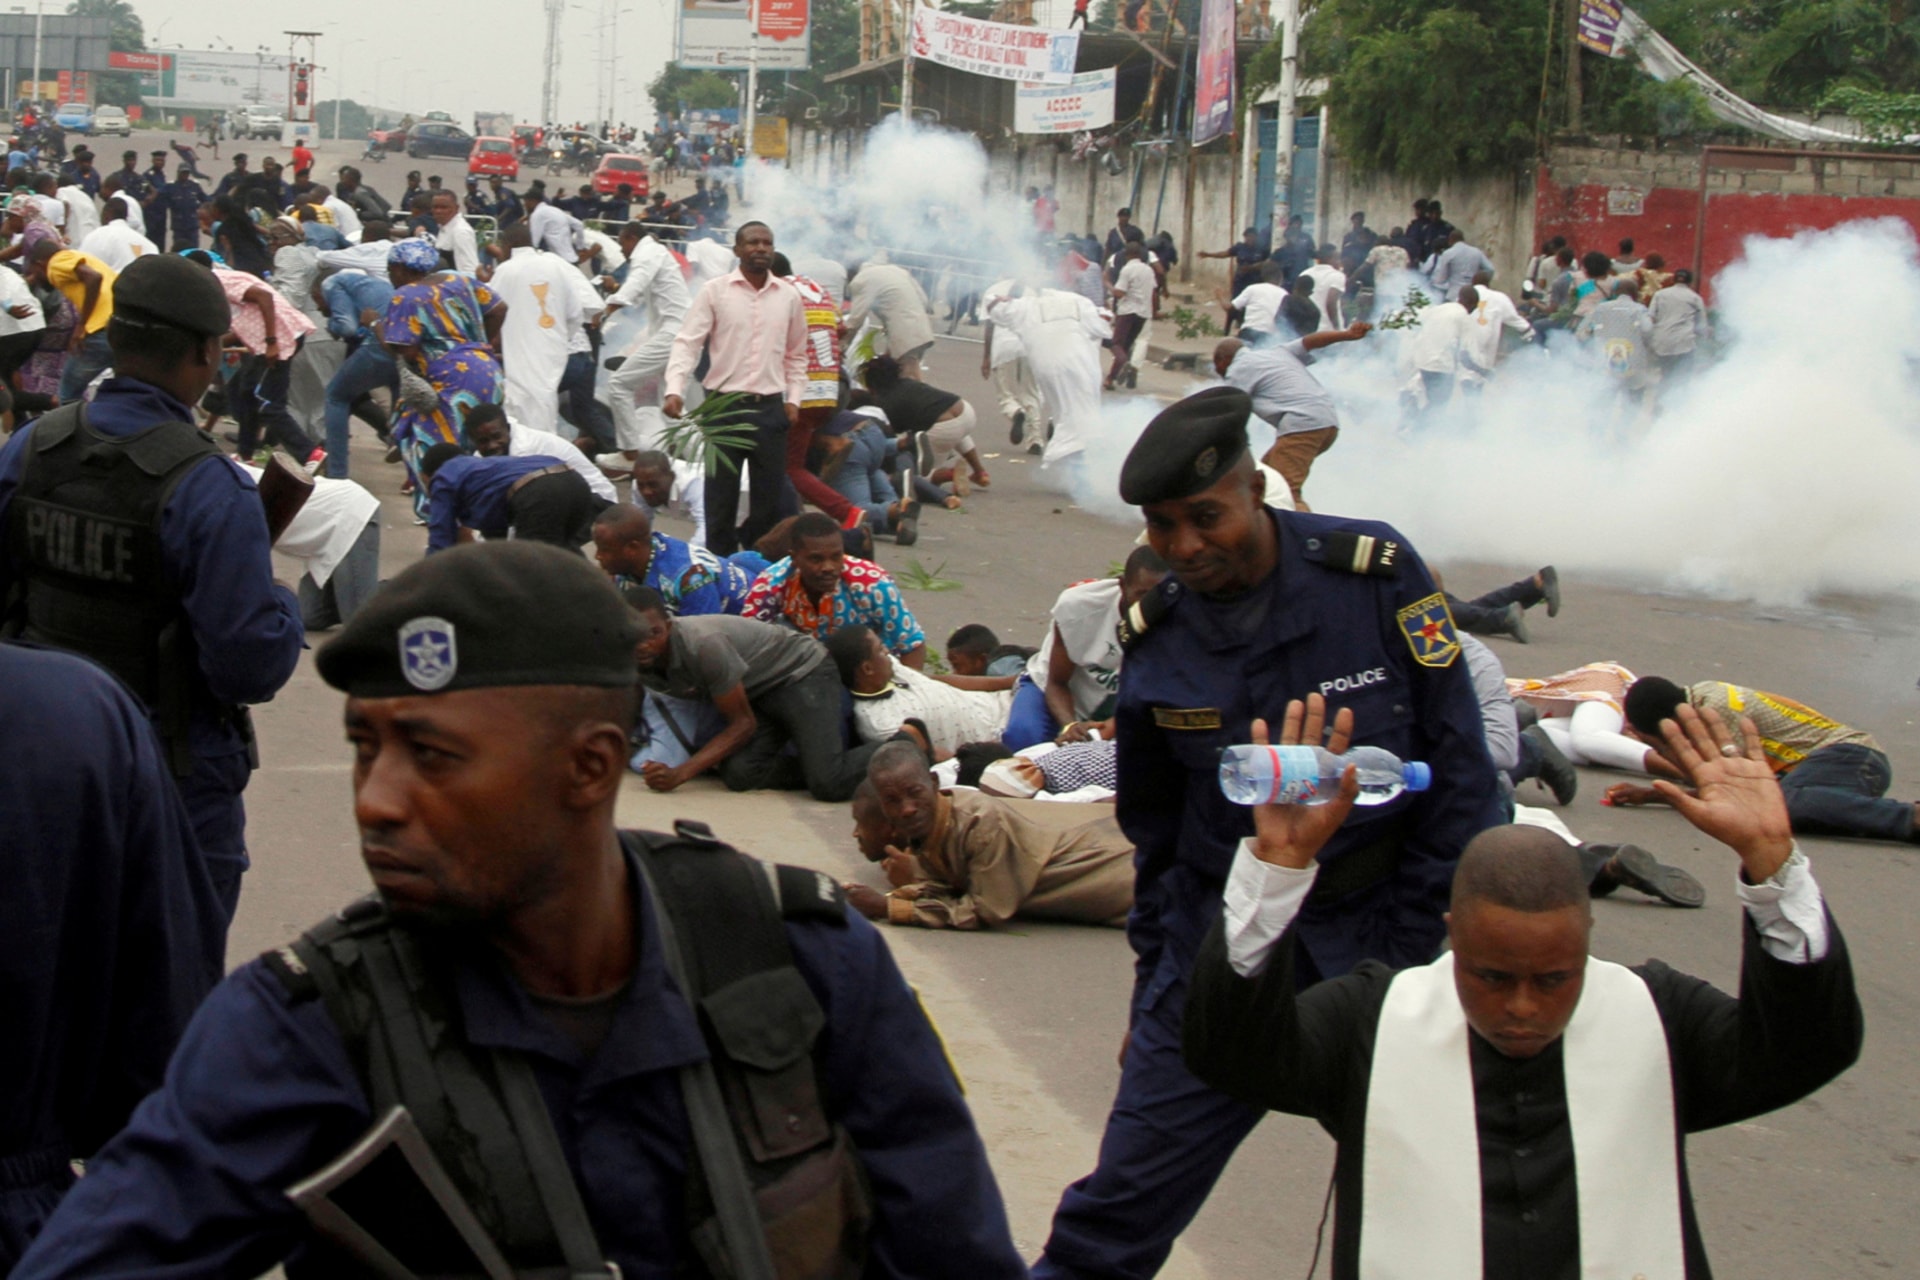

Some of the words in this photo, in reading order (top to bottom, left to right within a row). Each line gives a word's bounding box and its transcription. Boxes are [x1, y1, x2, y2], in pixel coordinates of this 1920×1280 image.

[26, 505, 133, 583] POLICE
[1380, 541, 1397, 565] PNC
[1319, 667, 1386, 697] POLICE
